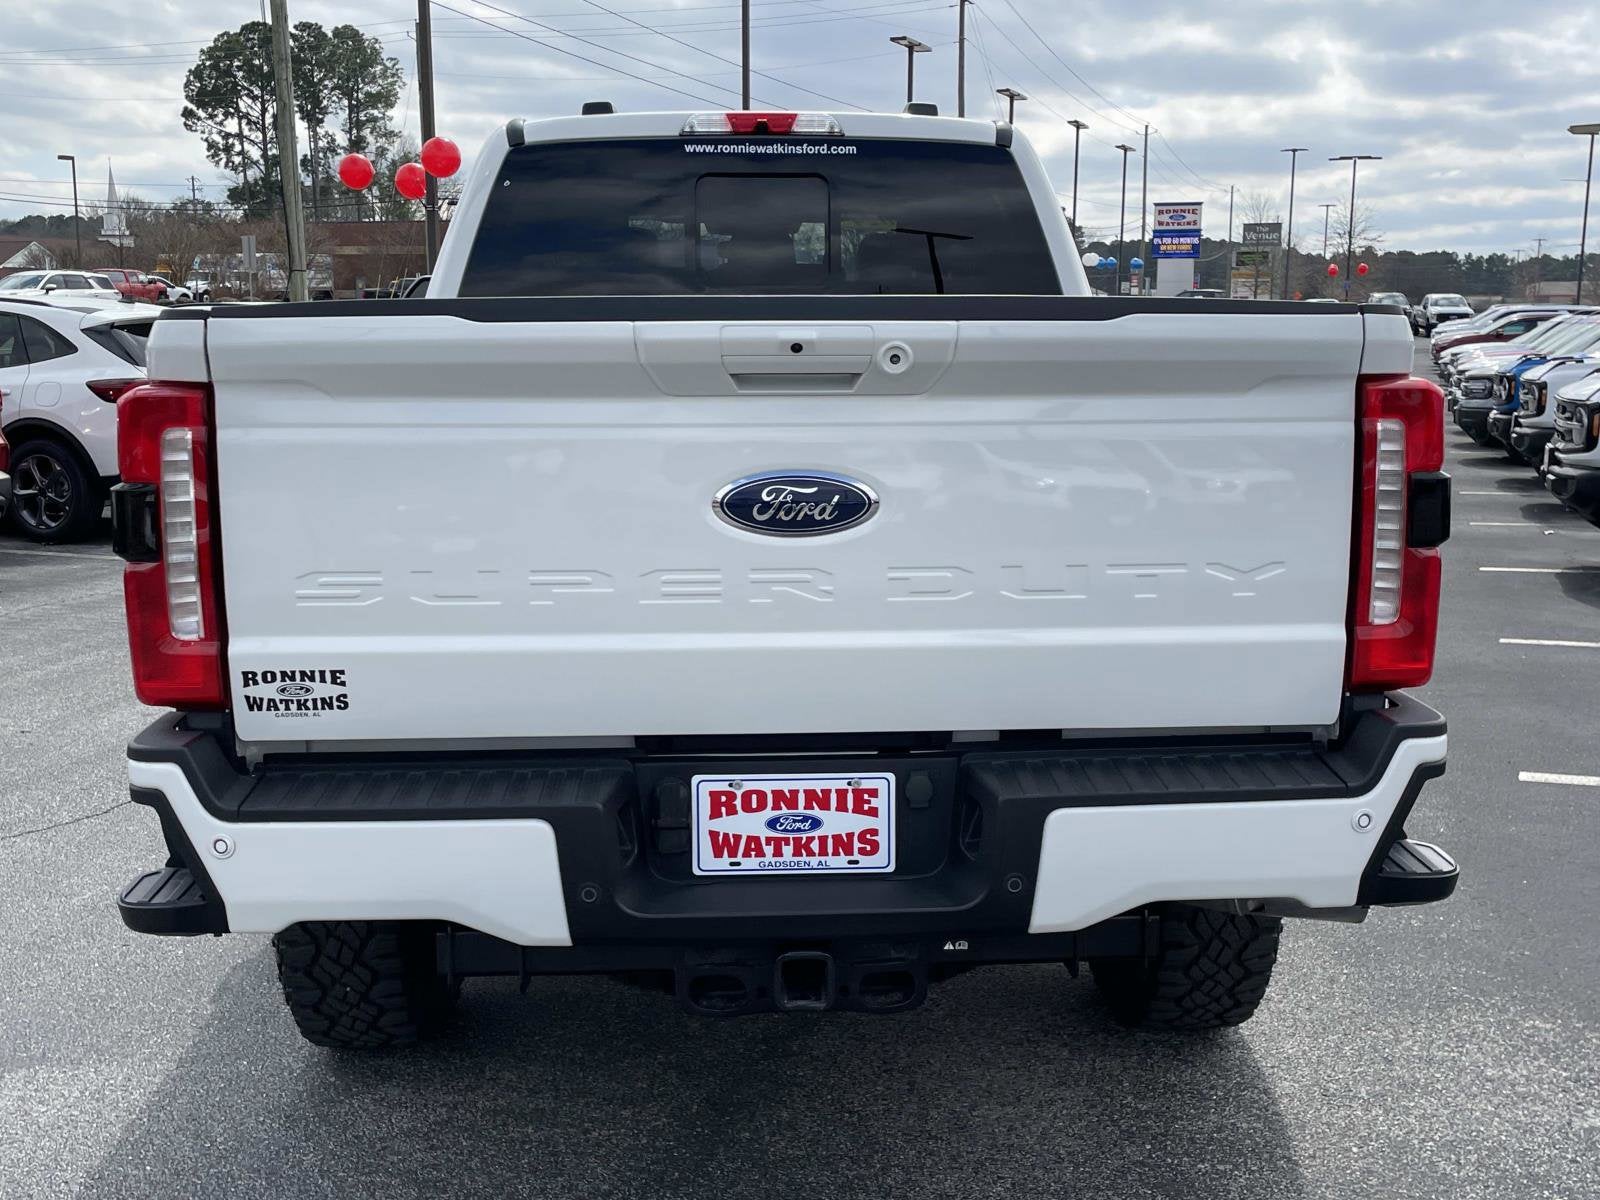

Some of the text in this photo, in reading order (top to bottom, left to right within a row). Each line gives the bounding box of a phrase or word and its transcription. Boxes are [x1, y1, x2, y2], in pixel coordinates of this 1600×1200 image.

[684, 143, 857, 154] www.ronniewatkinsford.com
[1157, 208, 1199, 216] RONNIE
[1157, 219, 1198, 227] WATKINS
[1162, 237, 1172, 245] FOR
[1179, 237, 1200, 245] MONTHS
[1245, 231, 1280, 240] Venue
[752, 485, 841, 521] Ford
[295, 561, 1287, 606] SUPER DUTY
[241, 669, 347, 688] RONNIE
[243, 693, 349, 712] WATKINS
[708, 788, 879, 820] RONNIE
[776, 816, 811, 831] Ford
[708, 828, 880, 859] WATKINS
[758, 859, 830, 869] GADSDEN, AL
